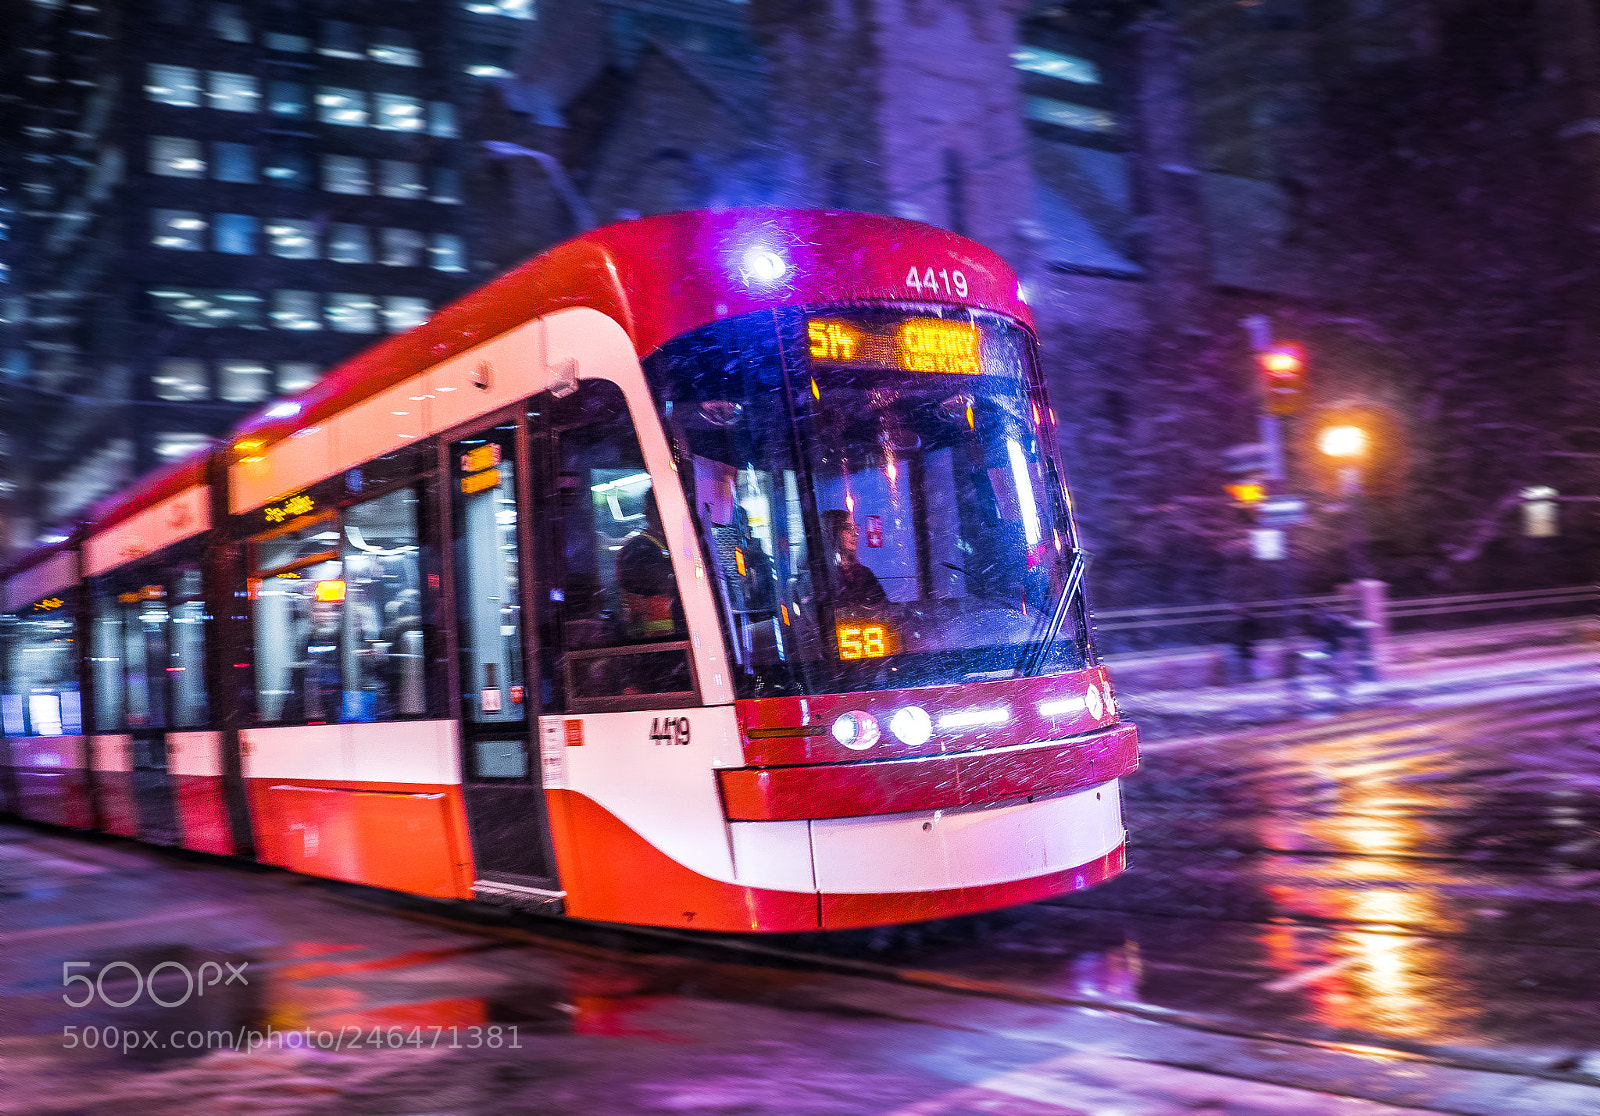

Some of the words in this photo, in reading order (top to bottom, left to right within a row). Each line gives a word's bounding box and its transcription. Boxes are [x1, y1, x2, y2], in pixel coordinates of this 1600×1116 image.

[905, 266, 968, 298] 4419
[839, 627, 885, 659] 58
[650, 716, 691, 746] 4419
